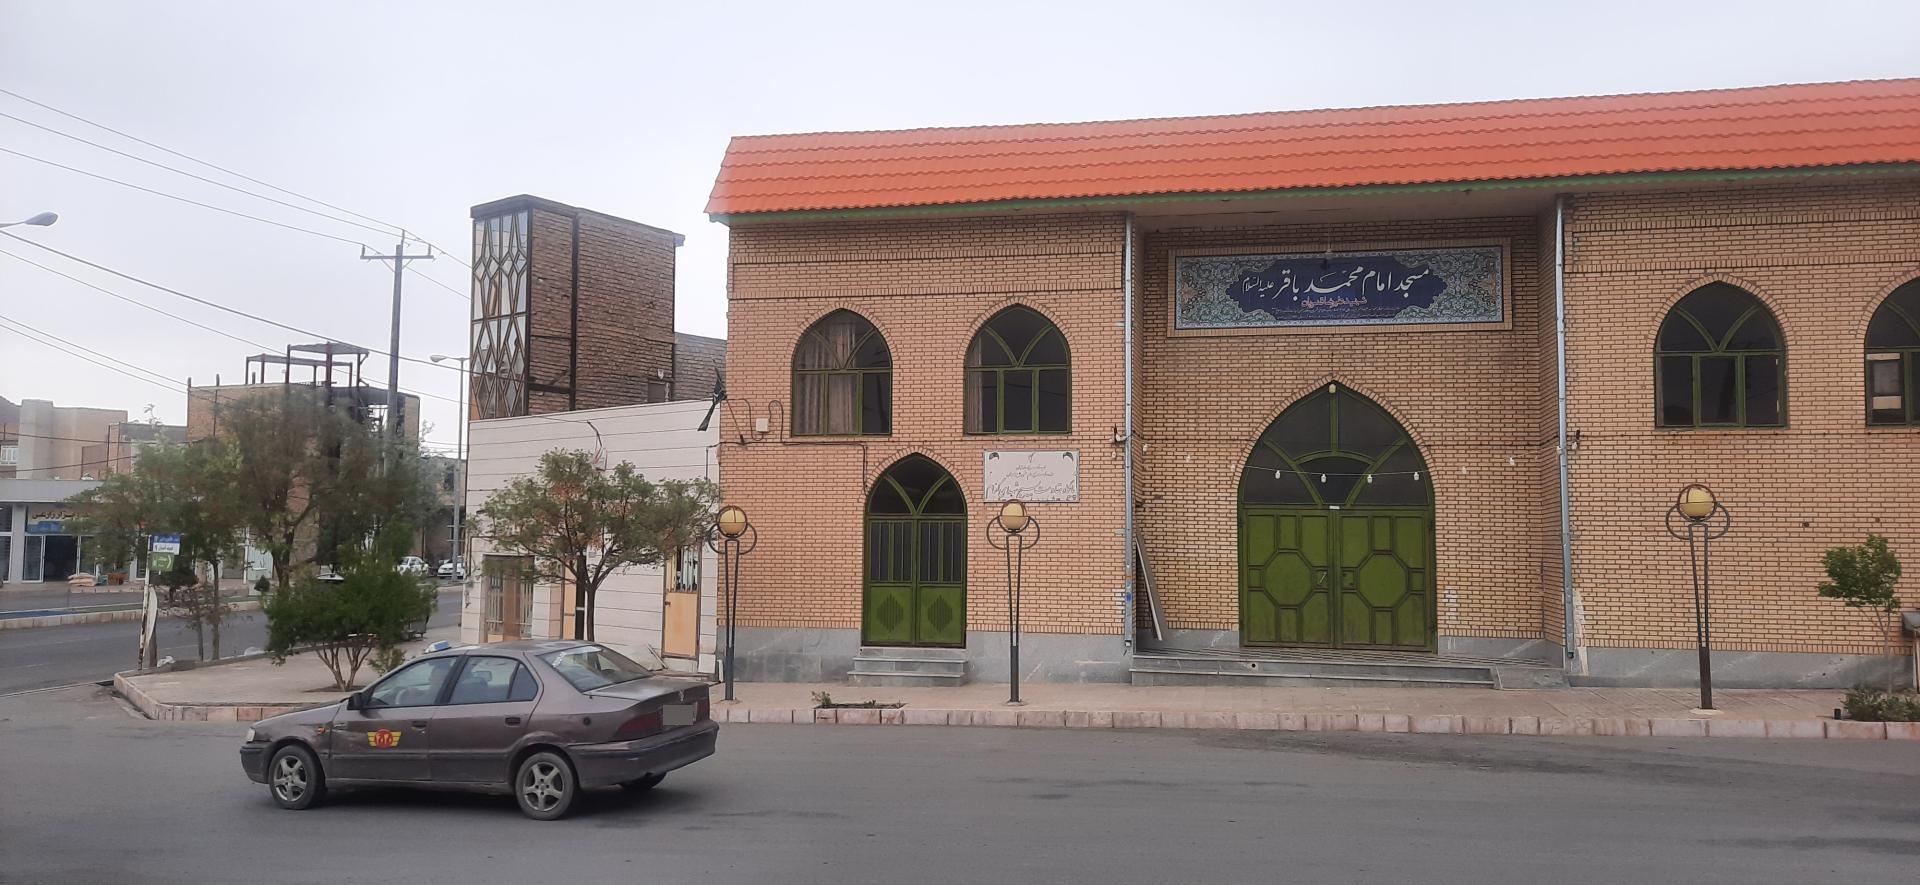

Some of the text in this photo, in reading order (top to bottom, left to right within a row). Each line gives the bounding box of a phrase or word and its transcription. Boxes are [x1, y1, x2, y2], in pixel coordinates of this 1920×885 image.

[1271, 268, 1300, 302] باقر
[1361, 270, 1392, 297] امام
[1393, 268, 1430, 298] مسجد
